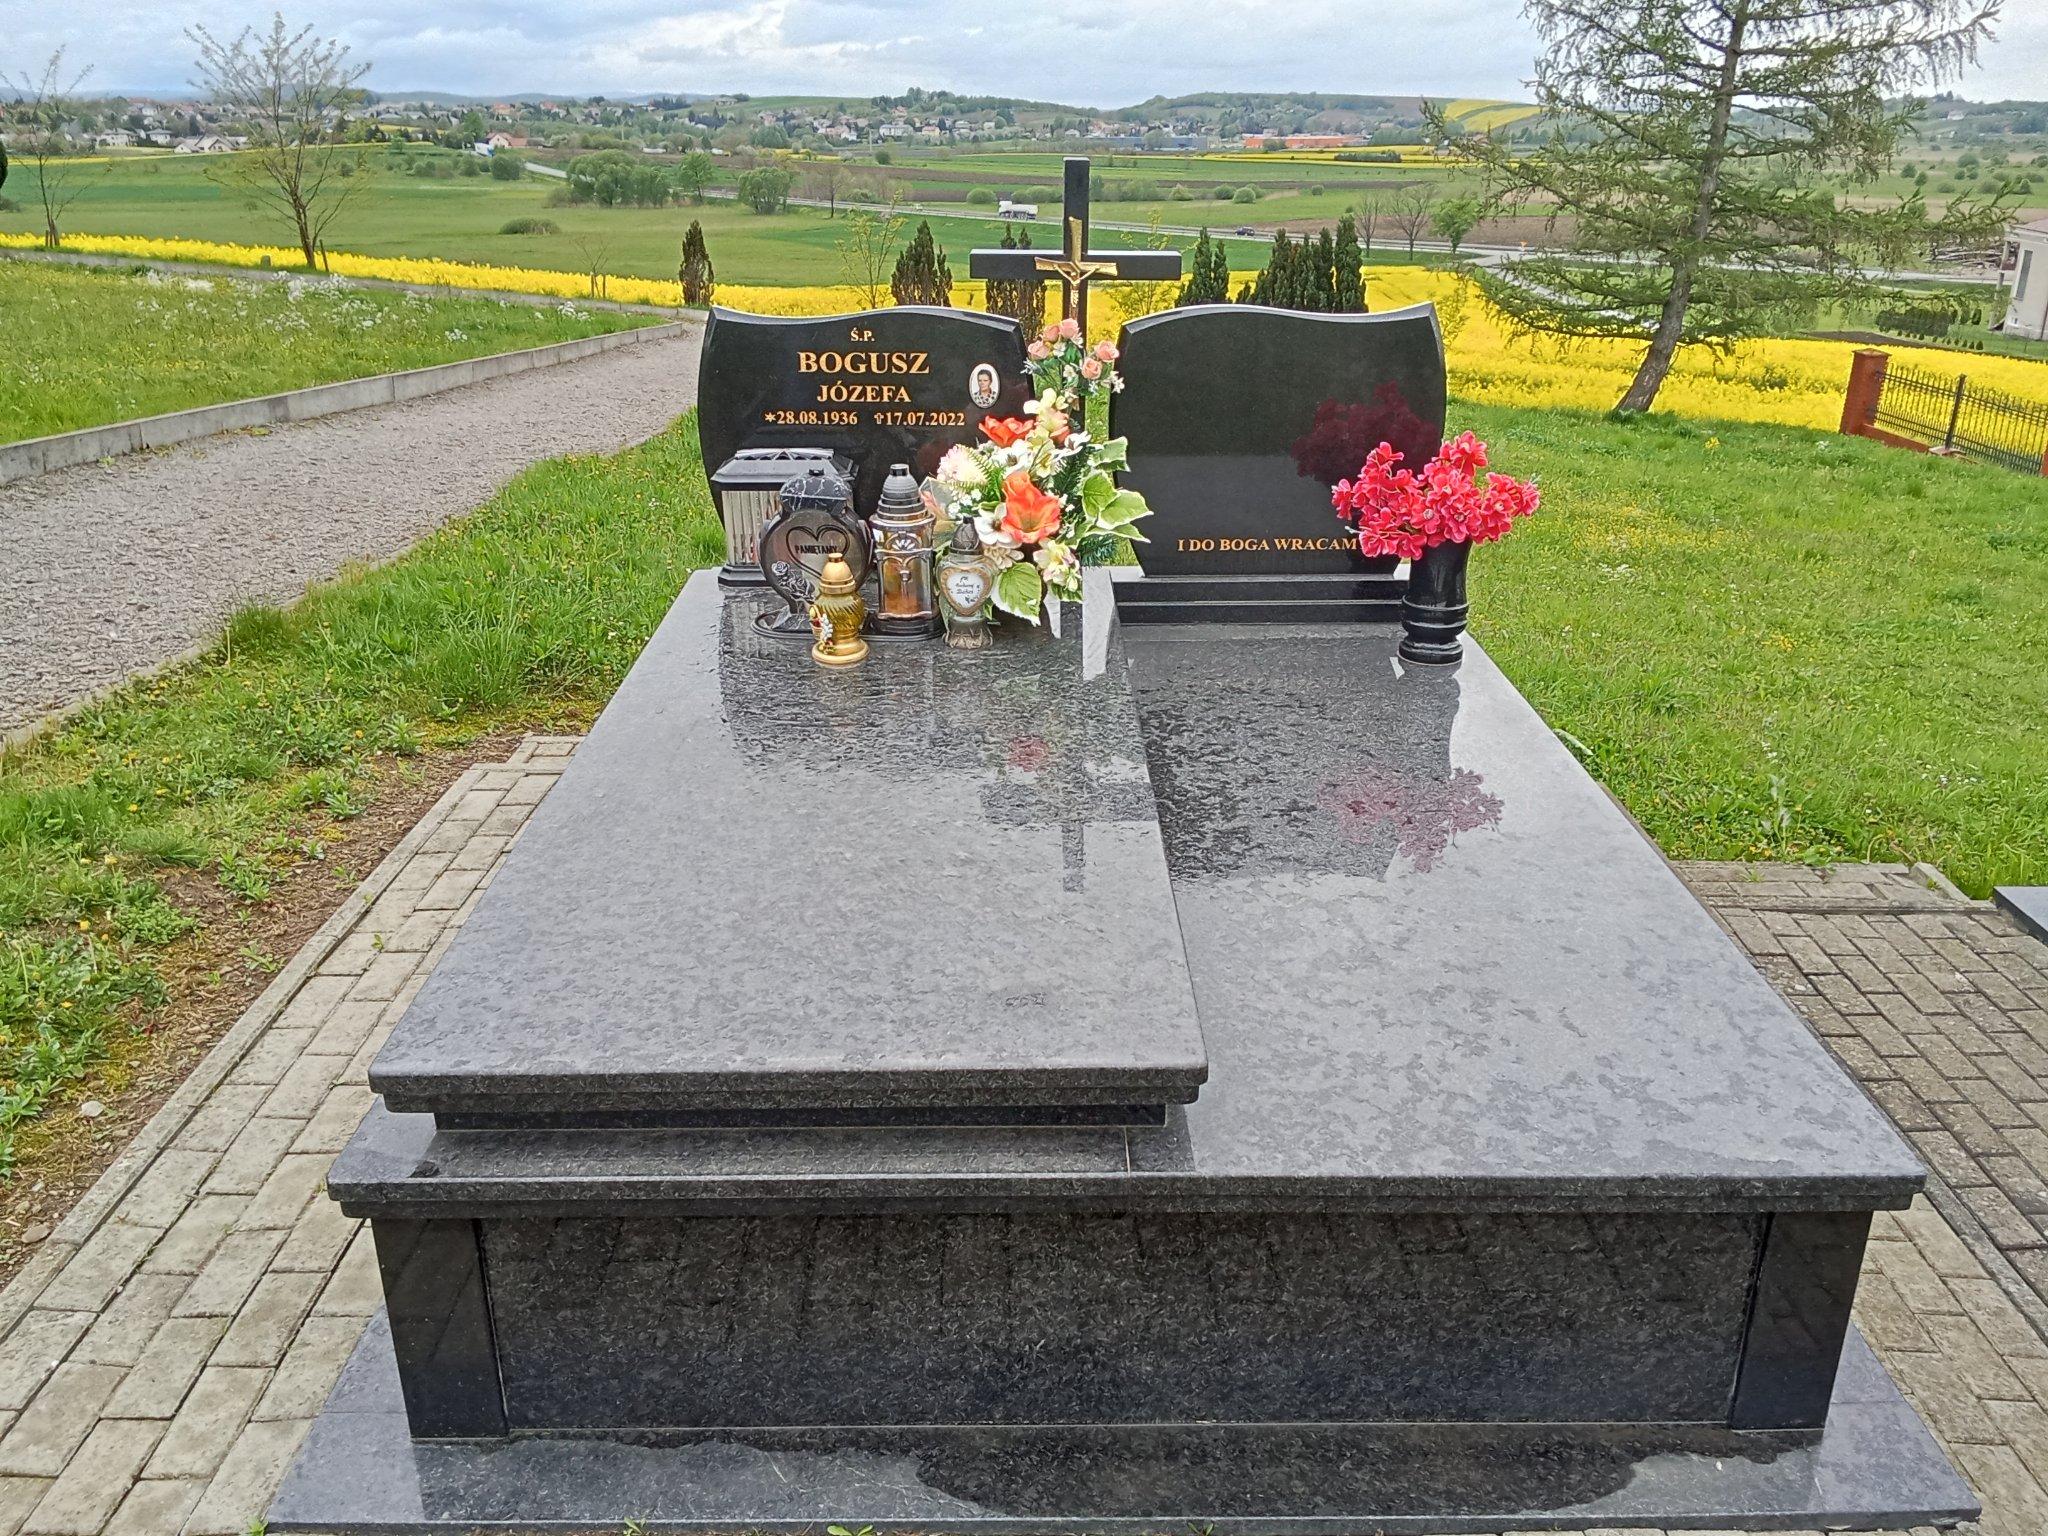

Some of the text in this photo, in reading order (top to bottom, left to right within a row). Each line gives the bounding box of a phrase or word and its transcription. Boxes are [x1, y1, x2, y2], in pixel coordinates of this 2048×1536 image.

[850, 327, 875, 342] Ś.P.
[797, 351, 930, 374] BOGUSZ
[816, 380, 911, 403] JÓZEFA
[1178, 537, 1361, 552] I DO BOGA WRACAM
